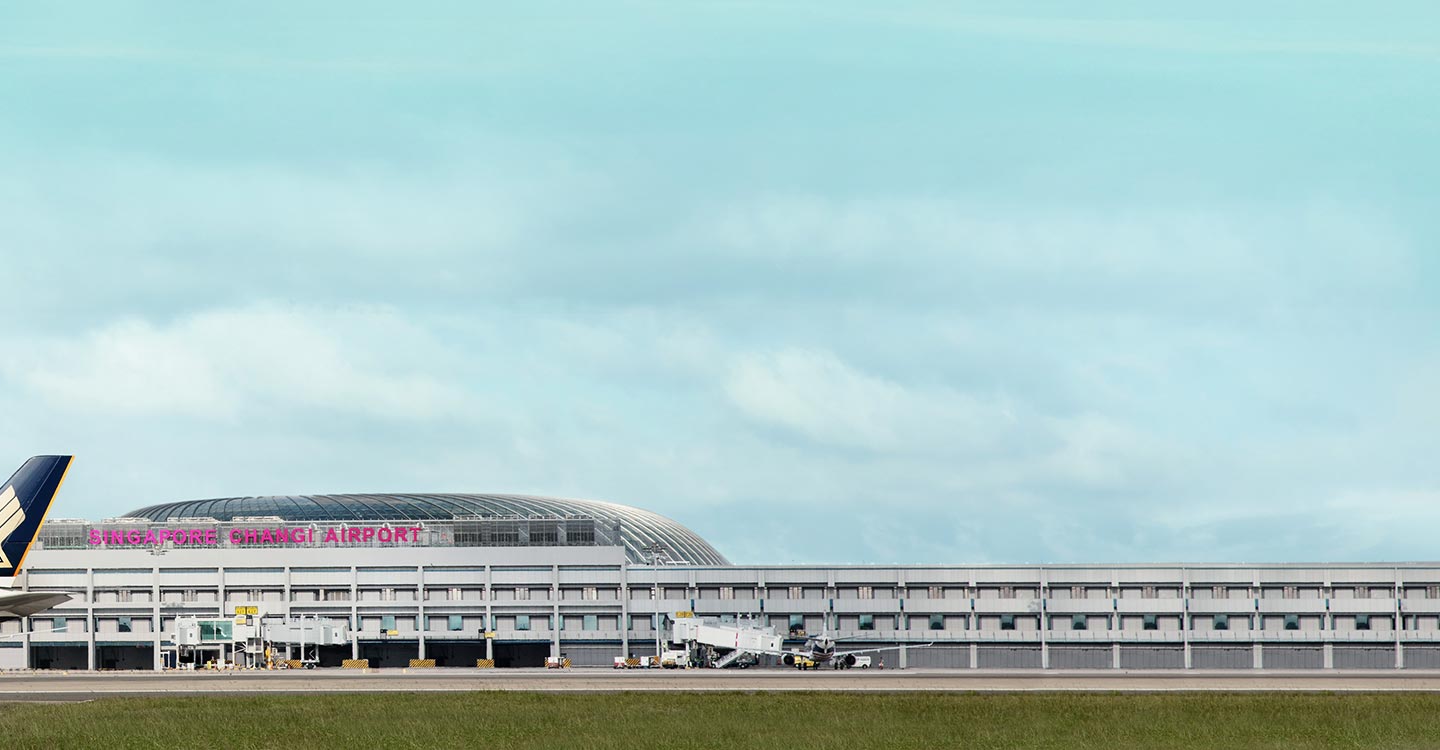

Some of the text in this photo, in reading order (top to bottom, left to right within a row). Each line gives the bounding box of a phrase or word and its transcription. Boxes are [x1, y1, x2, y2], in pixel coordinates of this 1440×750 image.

[89, 527, 422, 545] SINGAPORE CHANGI AIRPORT
